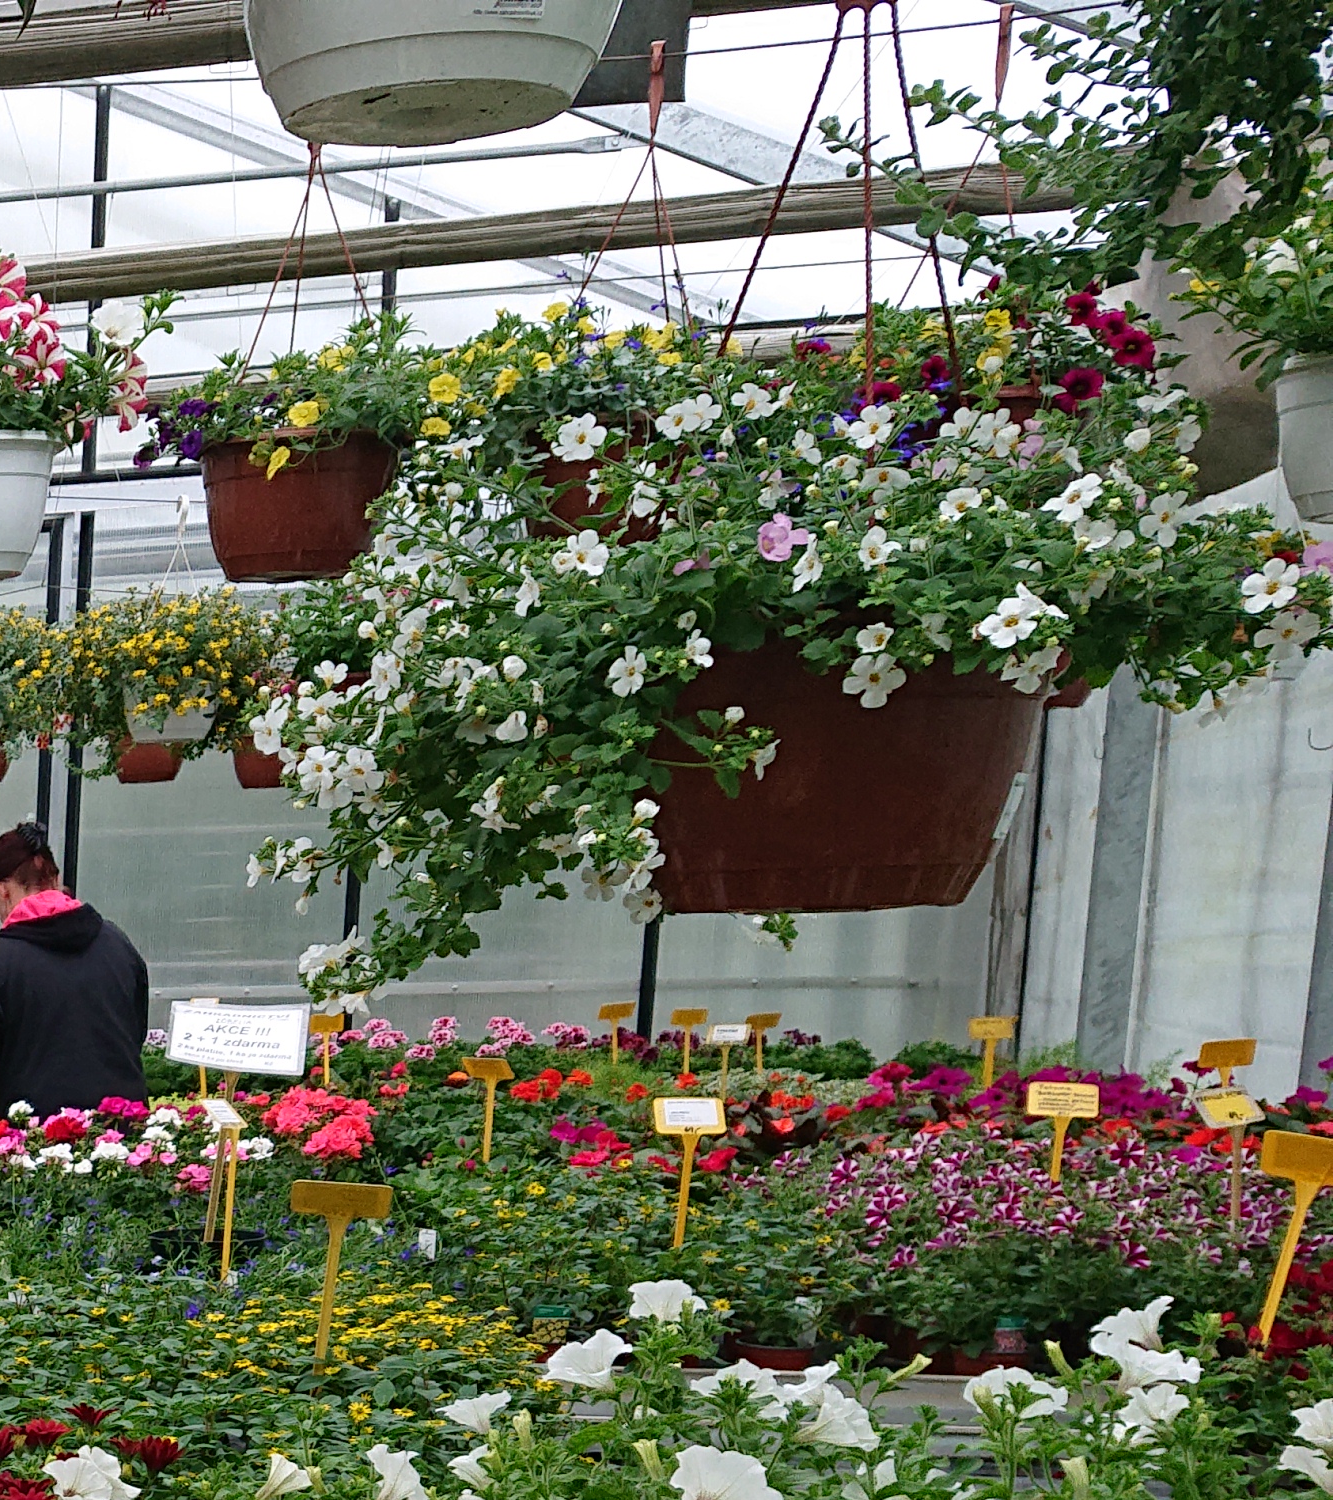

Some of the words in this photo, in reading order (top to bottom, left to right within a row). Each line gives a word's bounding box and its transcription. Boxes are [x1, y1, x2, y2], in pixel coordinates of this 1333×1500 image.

[203, 1024, 251, 1036] AKCE
[183, 1032, 192, 1041] 2
[223, 1038, 280, 1049] zdarma
